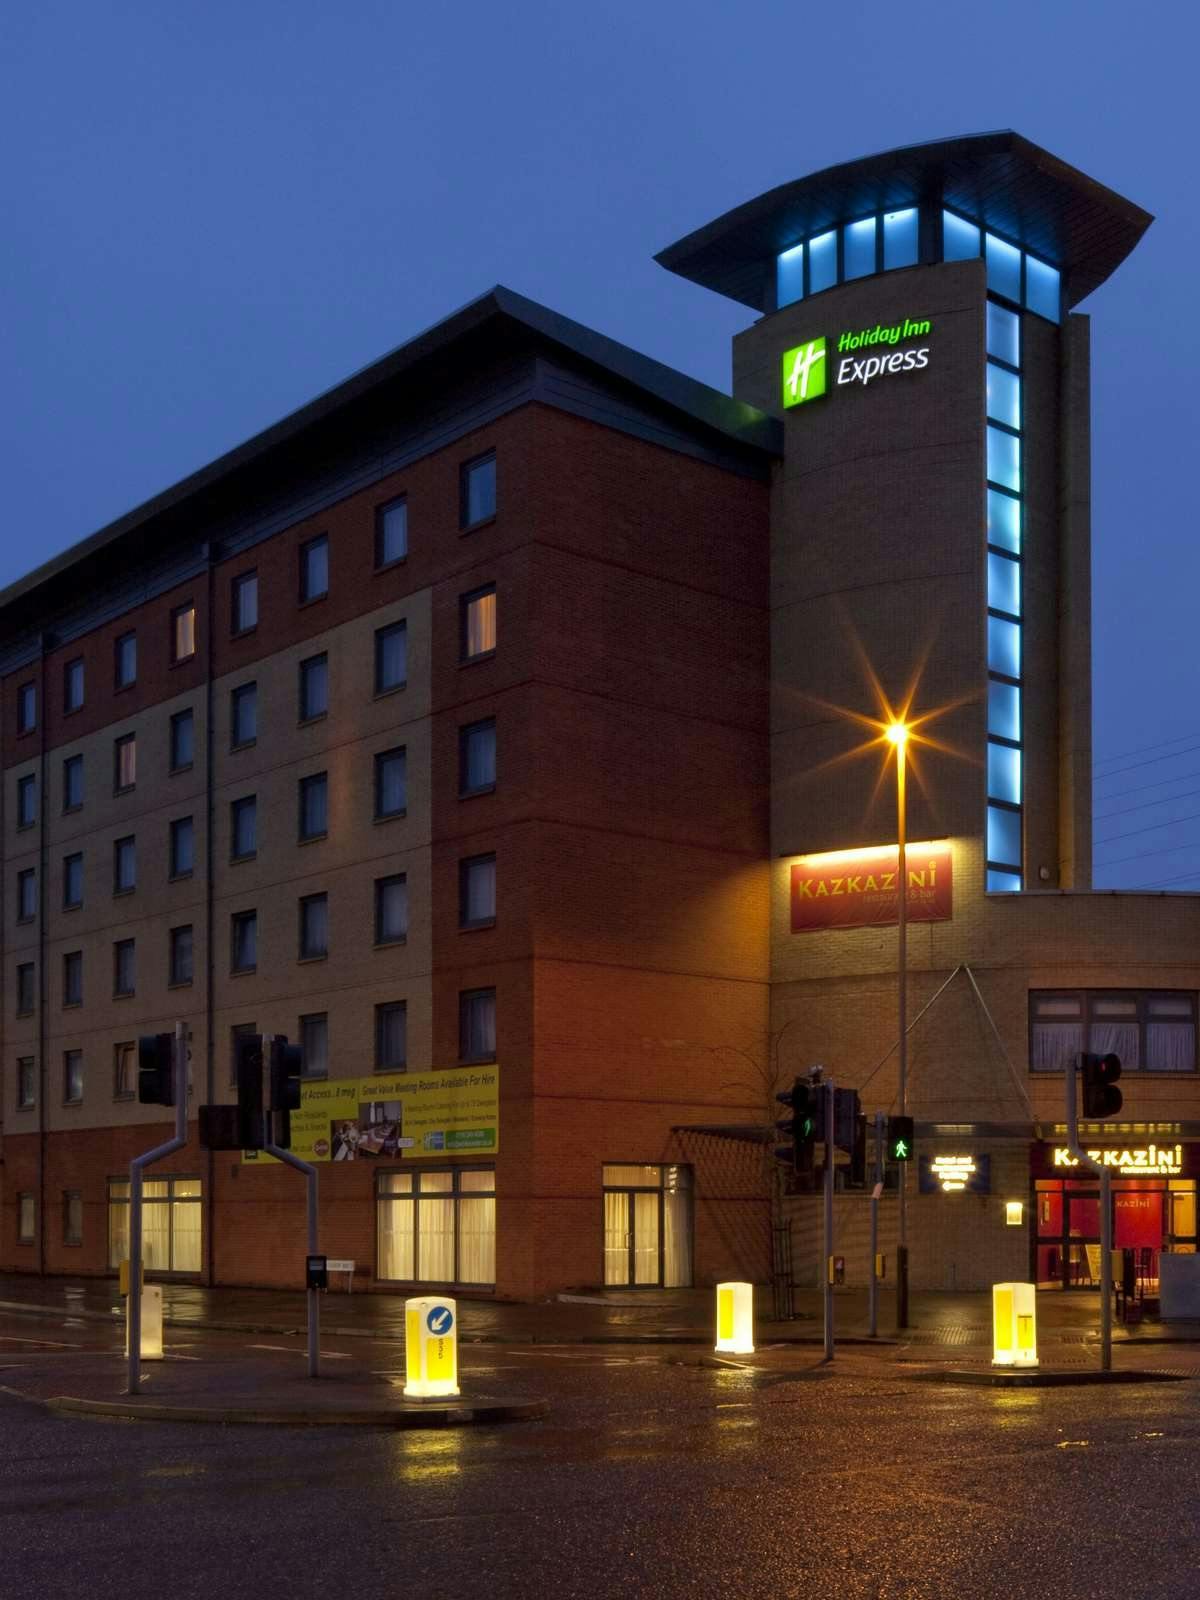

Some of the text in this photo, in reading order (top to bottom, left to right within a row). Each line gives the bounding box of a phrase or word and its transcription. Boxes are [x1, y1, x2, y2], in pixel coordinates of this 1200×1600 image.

[838, 319, 931, 352] Holiday Inn
[837, 348, 930, 385] Express
[799, 860, 937, 898] KAZKAZNi
